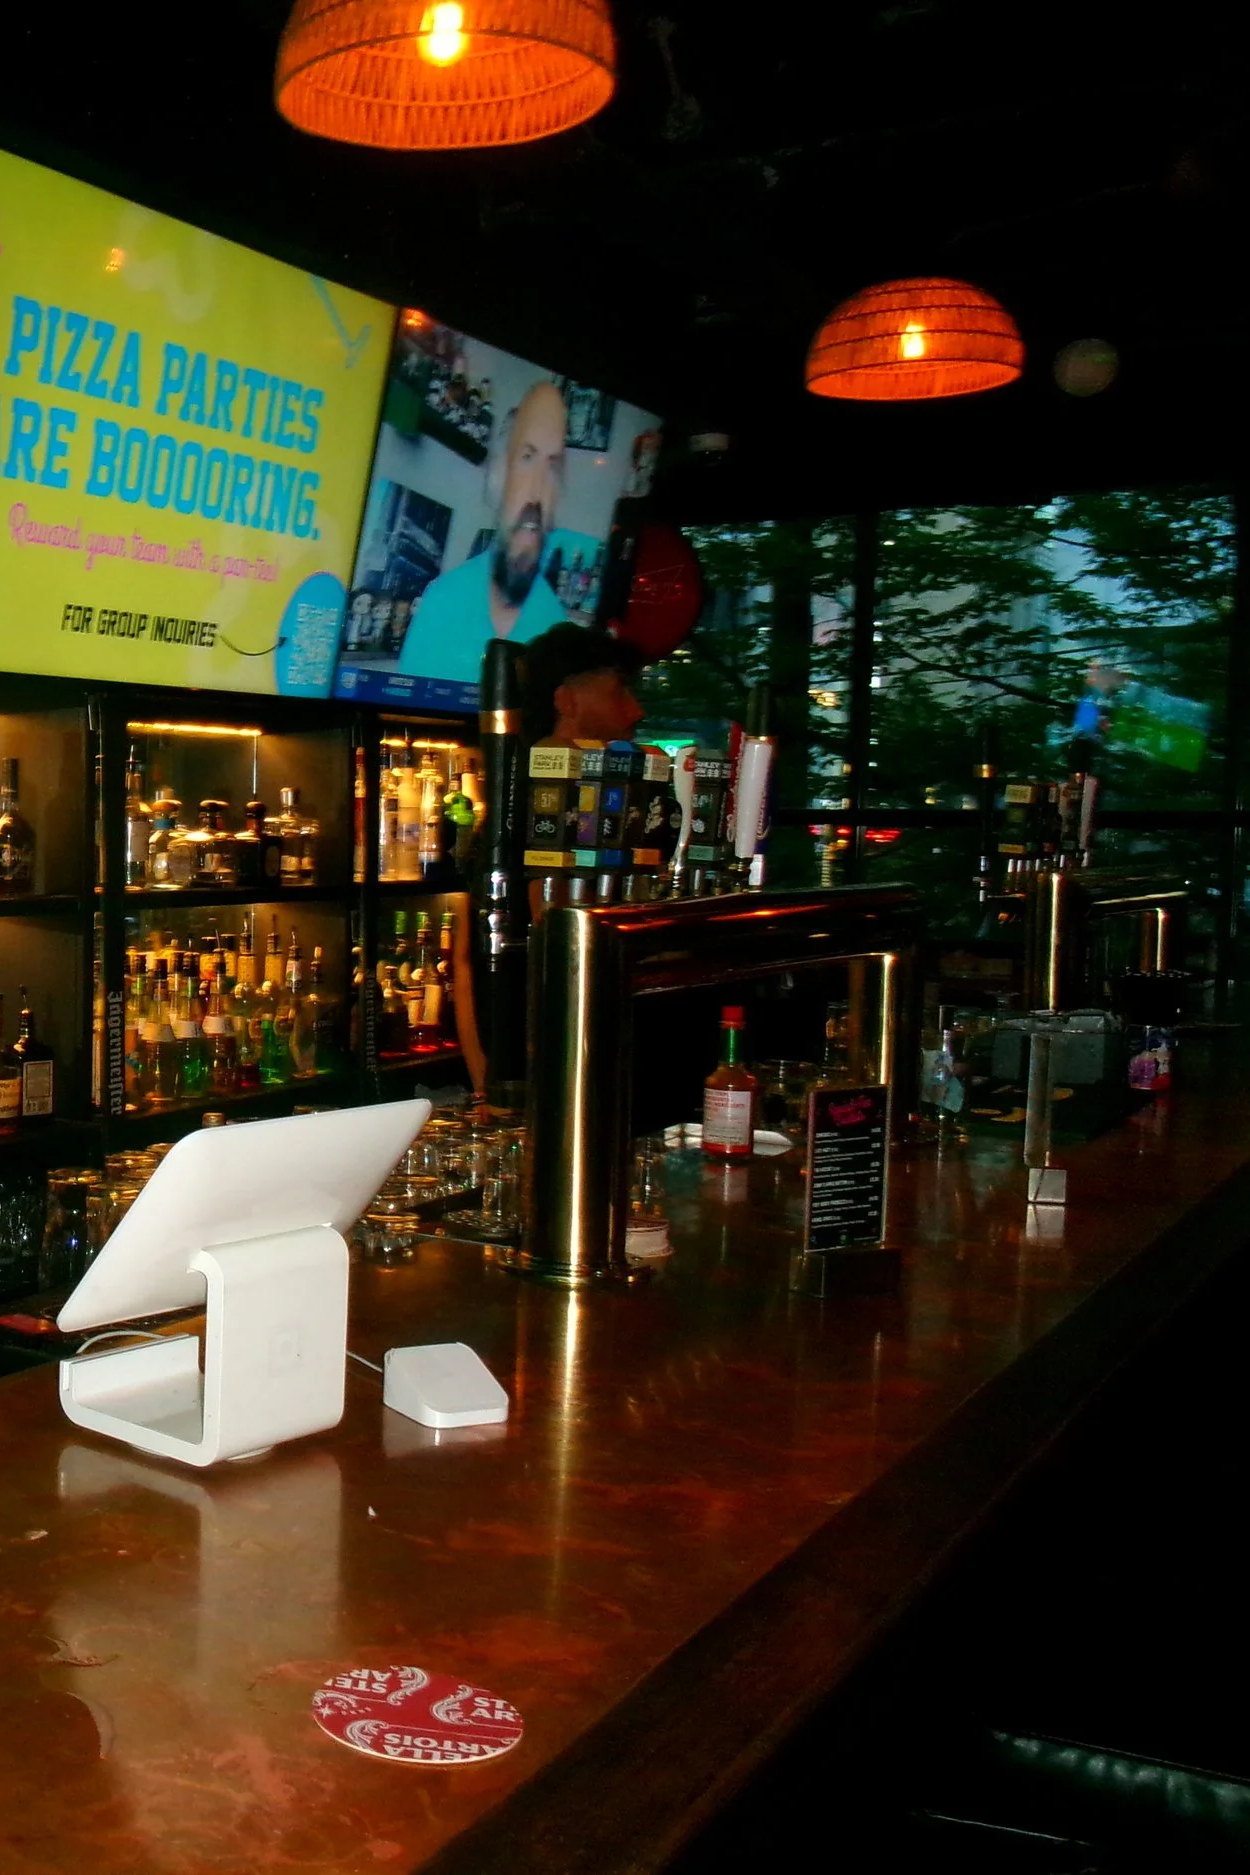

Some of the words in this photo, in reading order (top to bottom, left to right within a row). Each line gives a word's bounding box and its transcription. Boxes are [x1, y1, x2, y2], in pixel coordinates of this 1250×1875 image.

[4, 295, 141, 408] PIZZA
[154, 342, 325, 453] PARTIES
[85, 418, 321, 541] BOOOORING.
[61, 603, 93, 633] FOR
[97, 608, 147, 639] GROUP
[150, 615, 218, 647] INQUIRIES
